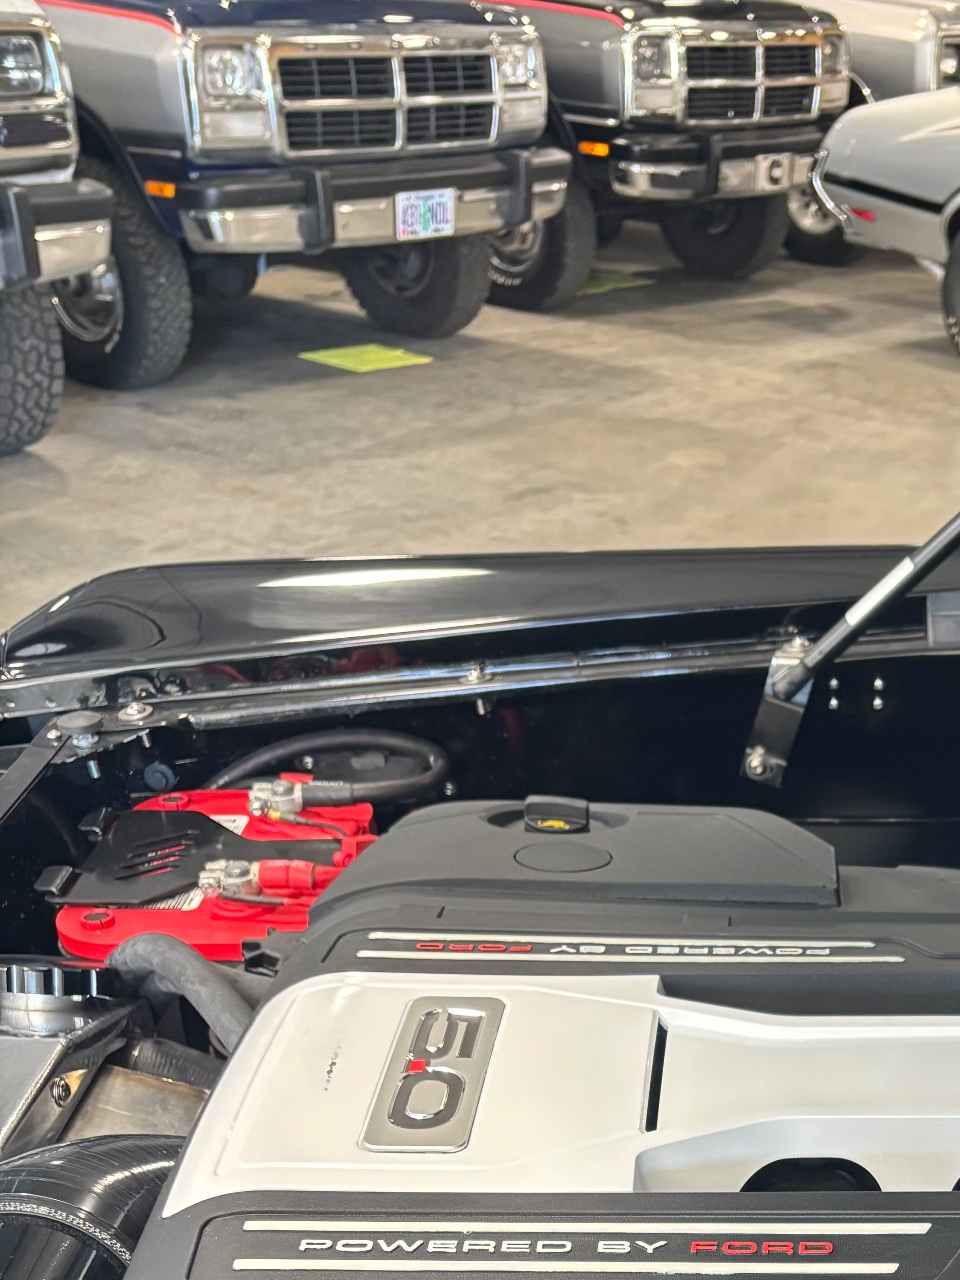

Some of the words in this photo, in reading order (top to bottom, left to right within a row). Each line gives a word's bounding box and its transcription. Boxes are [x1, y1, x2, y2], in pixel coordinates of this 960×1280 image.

[416, 943, 532, 952] FORD
[550, 945, 606, 954] BY
[625, 946, 831, 956] POWERED
[388, 1008, 486, 1129] 5.0
[299, 1239, 571, 1254] POWERED
[597, 1240, 668, 1254] BY
[690, 1240, 834, 1255] FORD
